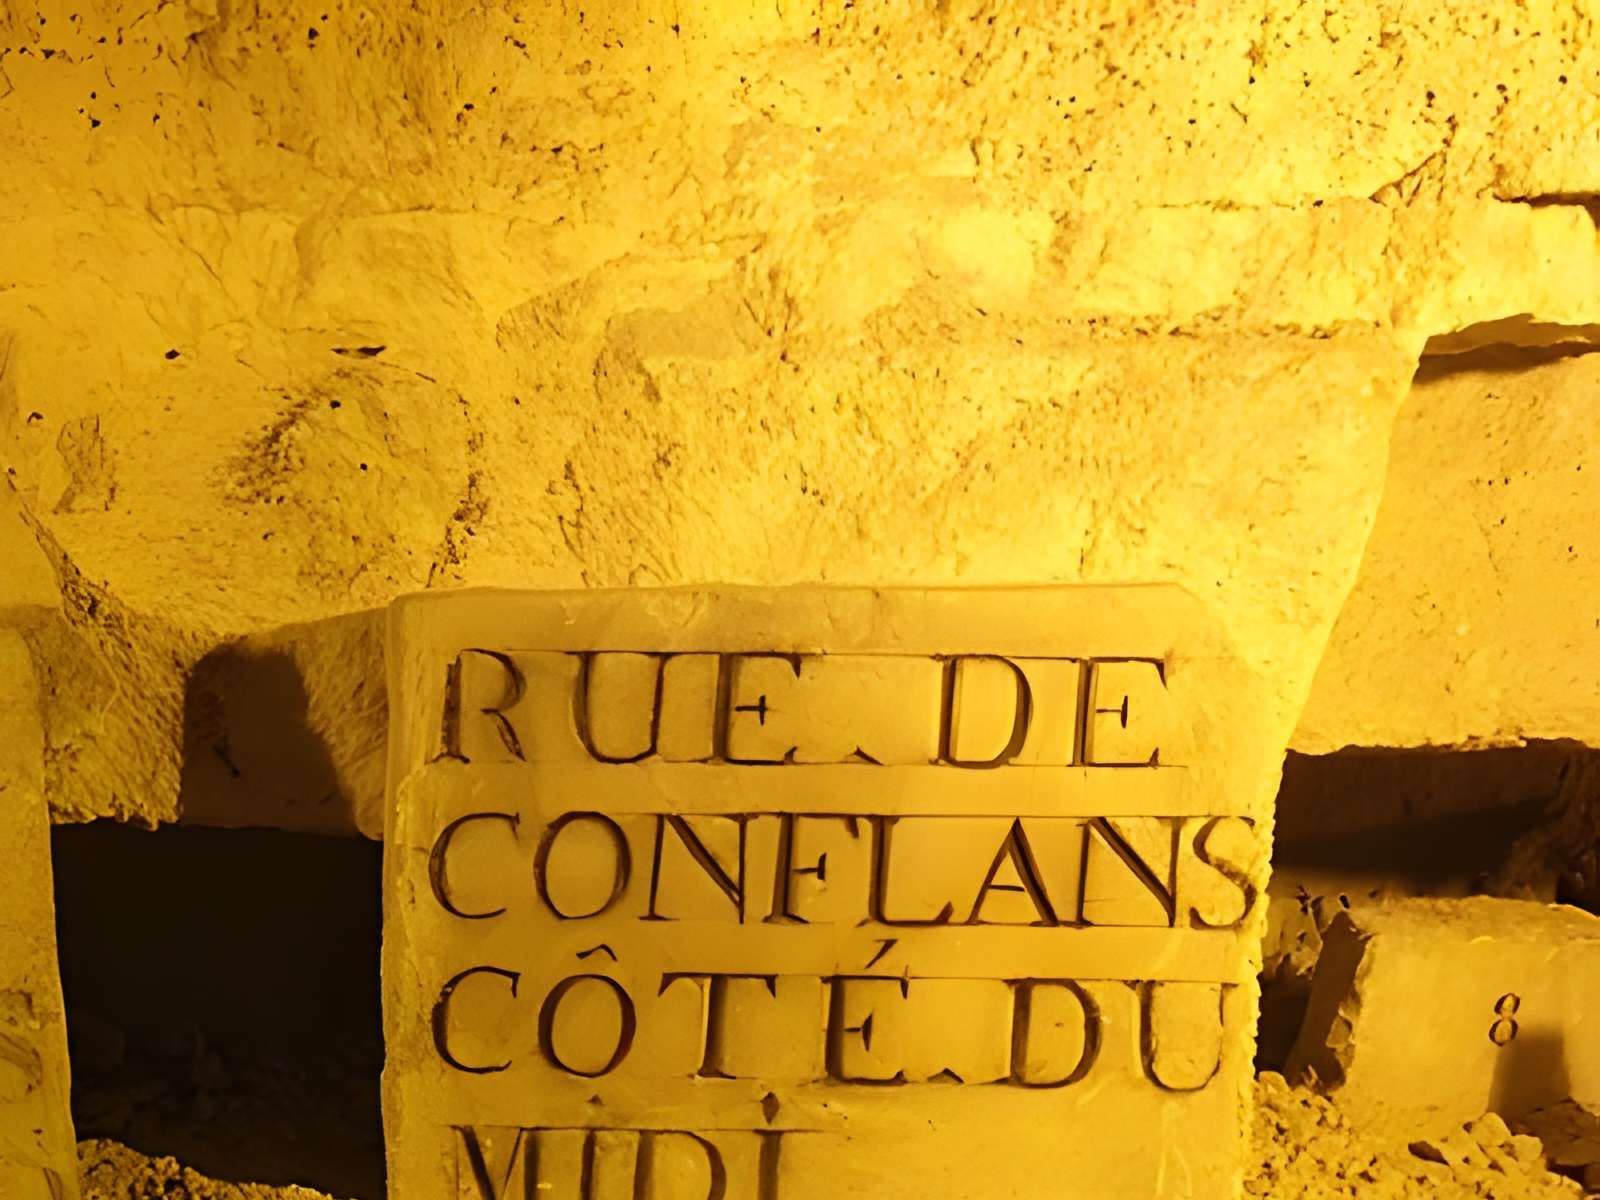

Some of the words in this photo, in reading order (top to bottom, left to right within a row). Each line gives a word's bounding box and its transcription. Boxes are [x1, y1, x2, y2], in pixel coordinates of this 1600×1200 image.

[426, 648, 802, 766] RUE
[929, 650, 1174, 770] DE
[428, 811, 1258, 930] CONFLANS
[430, 938, 912, 1086] CÔTÉ
[1003, 977, 1237, 1092] DU
[1488, 991, 1521, 1048] 8
